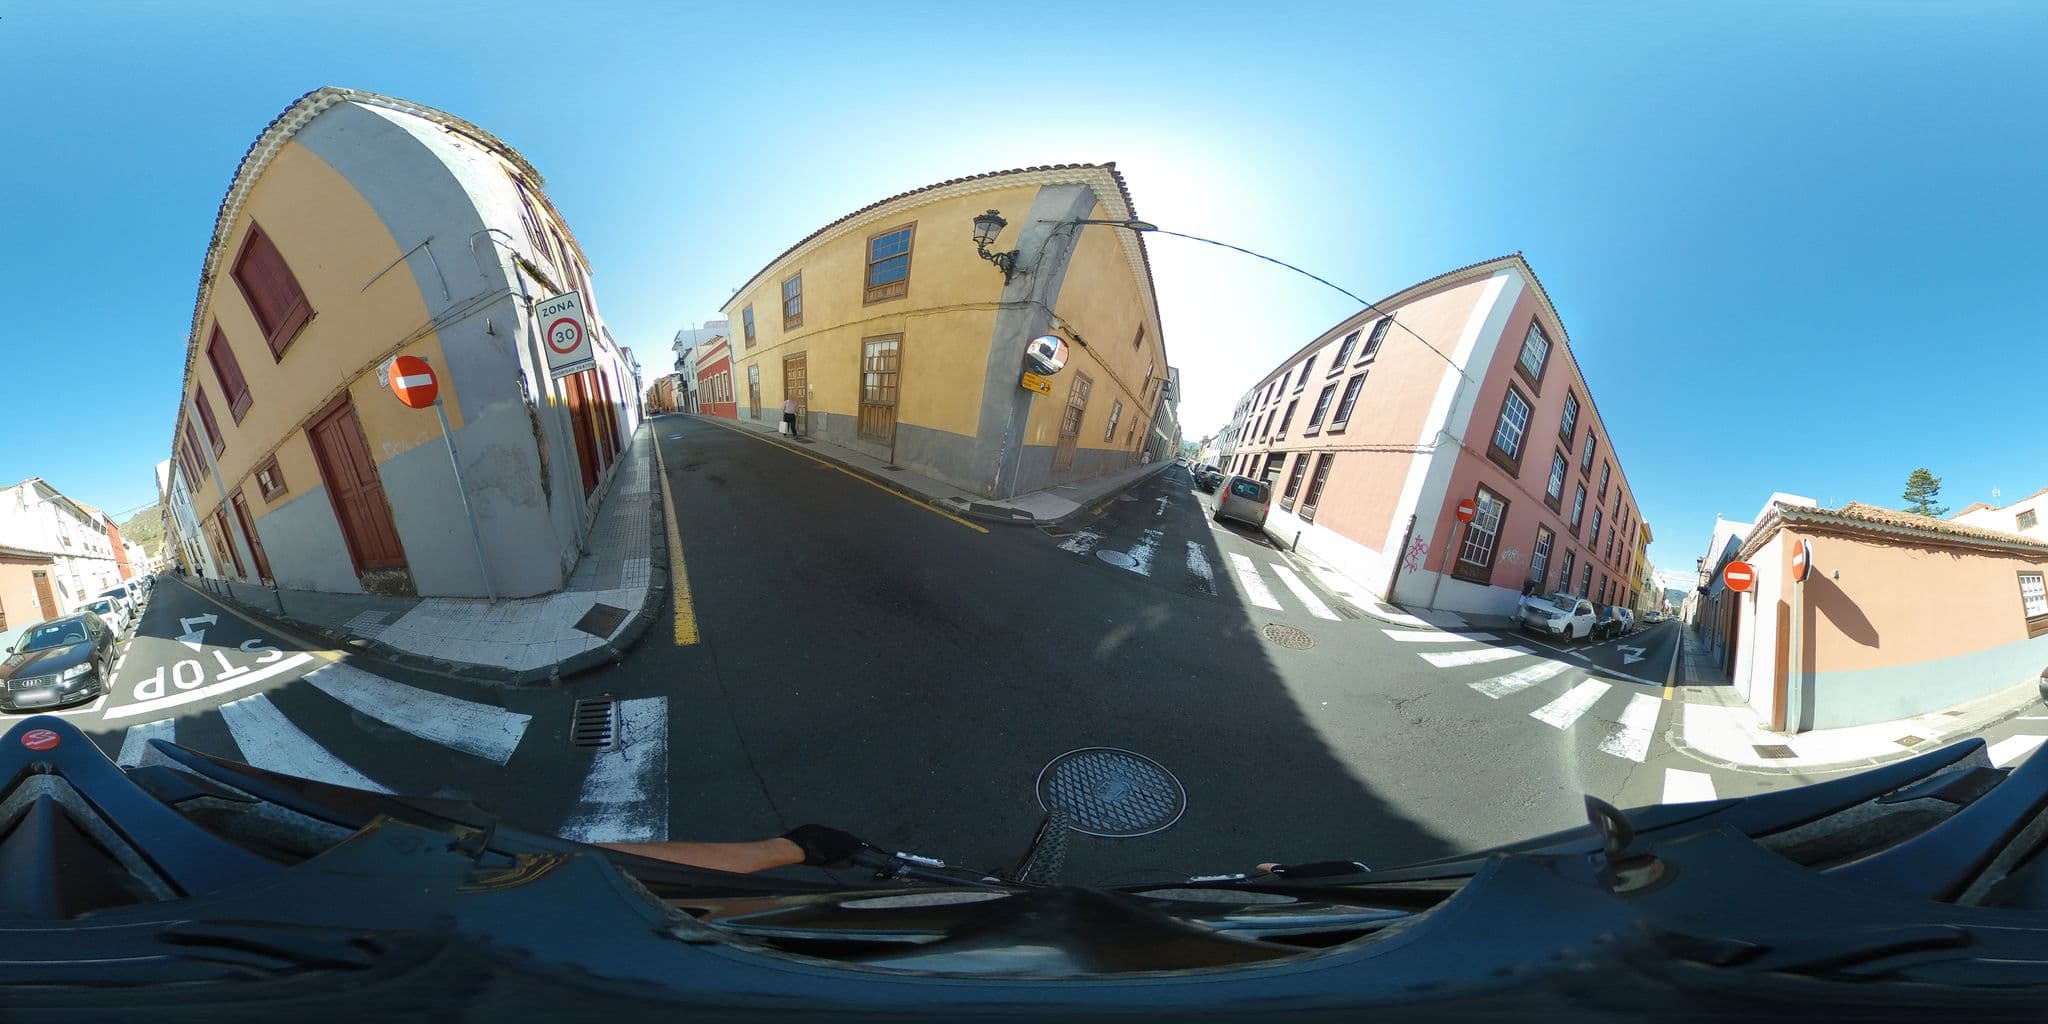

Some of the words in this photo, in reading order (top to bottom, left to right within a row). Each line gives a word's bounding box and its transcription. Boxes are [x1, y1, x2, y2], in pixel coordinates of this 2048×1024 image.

[542, 300, 575, 317] ZONA
[555, 328, 575, 343] 30
[133, 639, 283, 701] STOP
